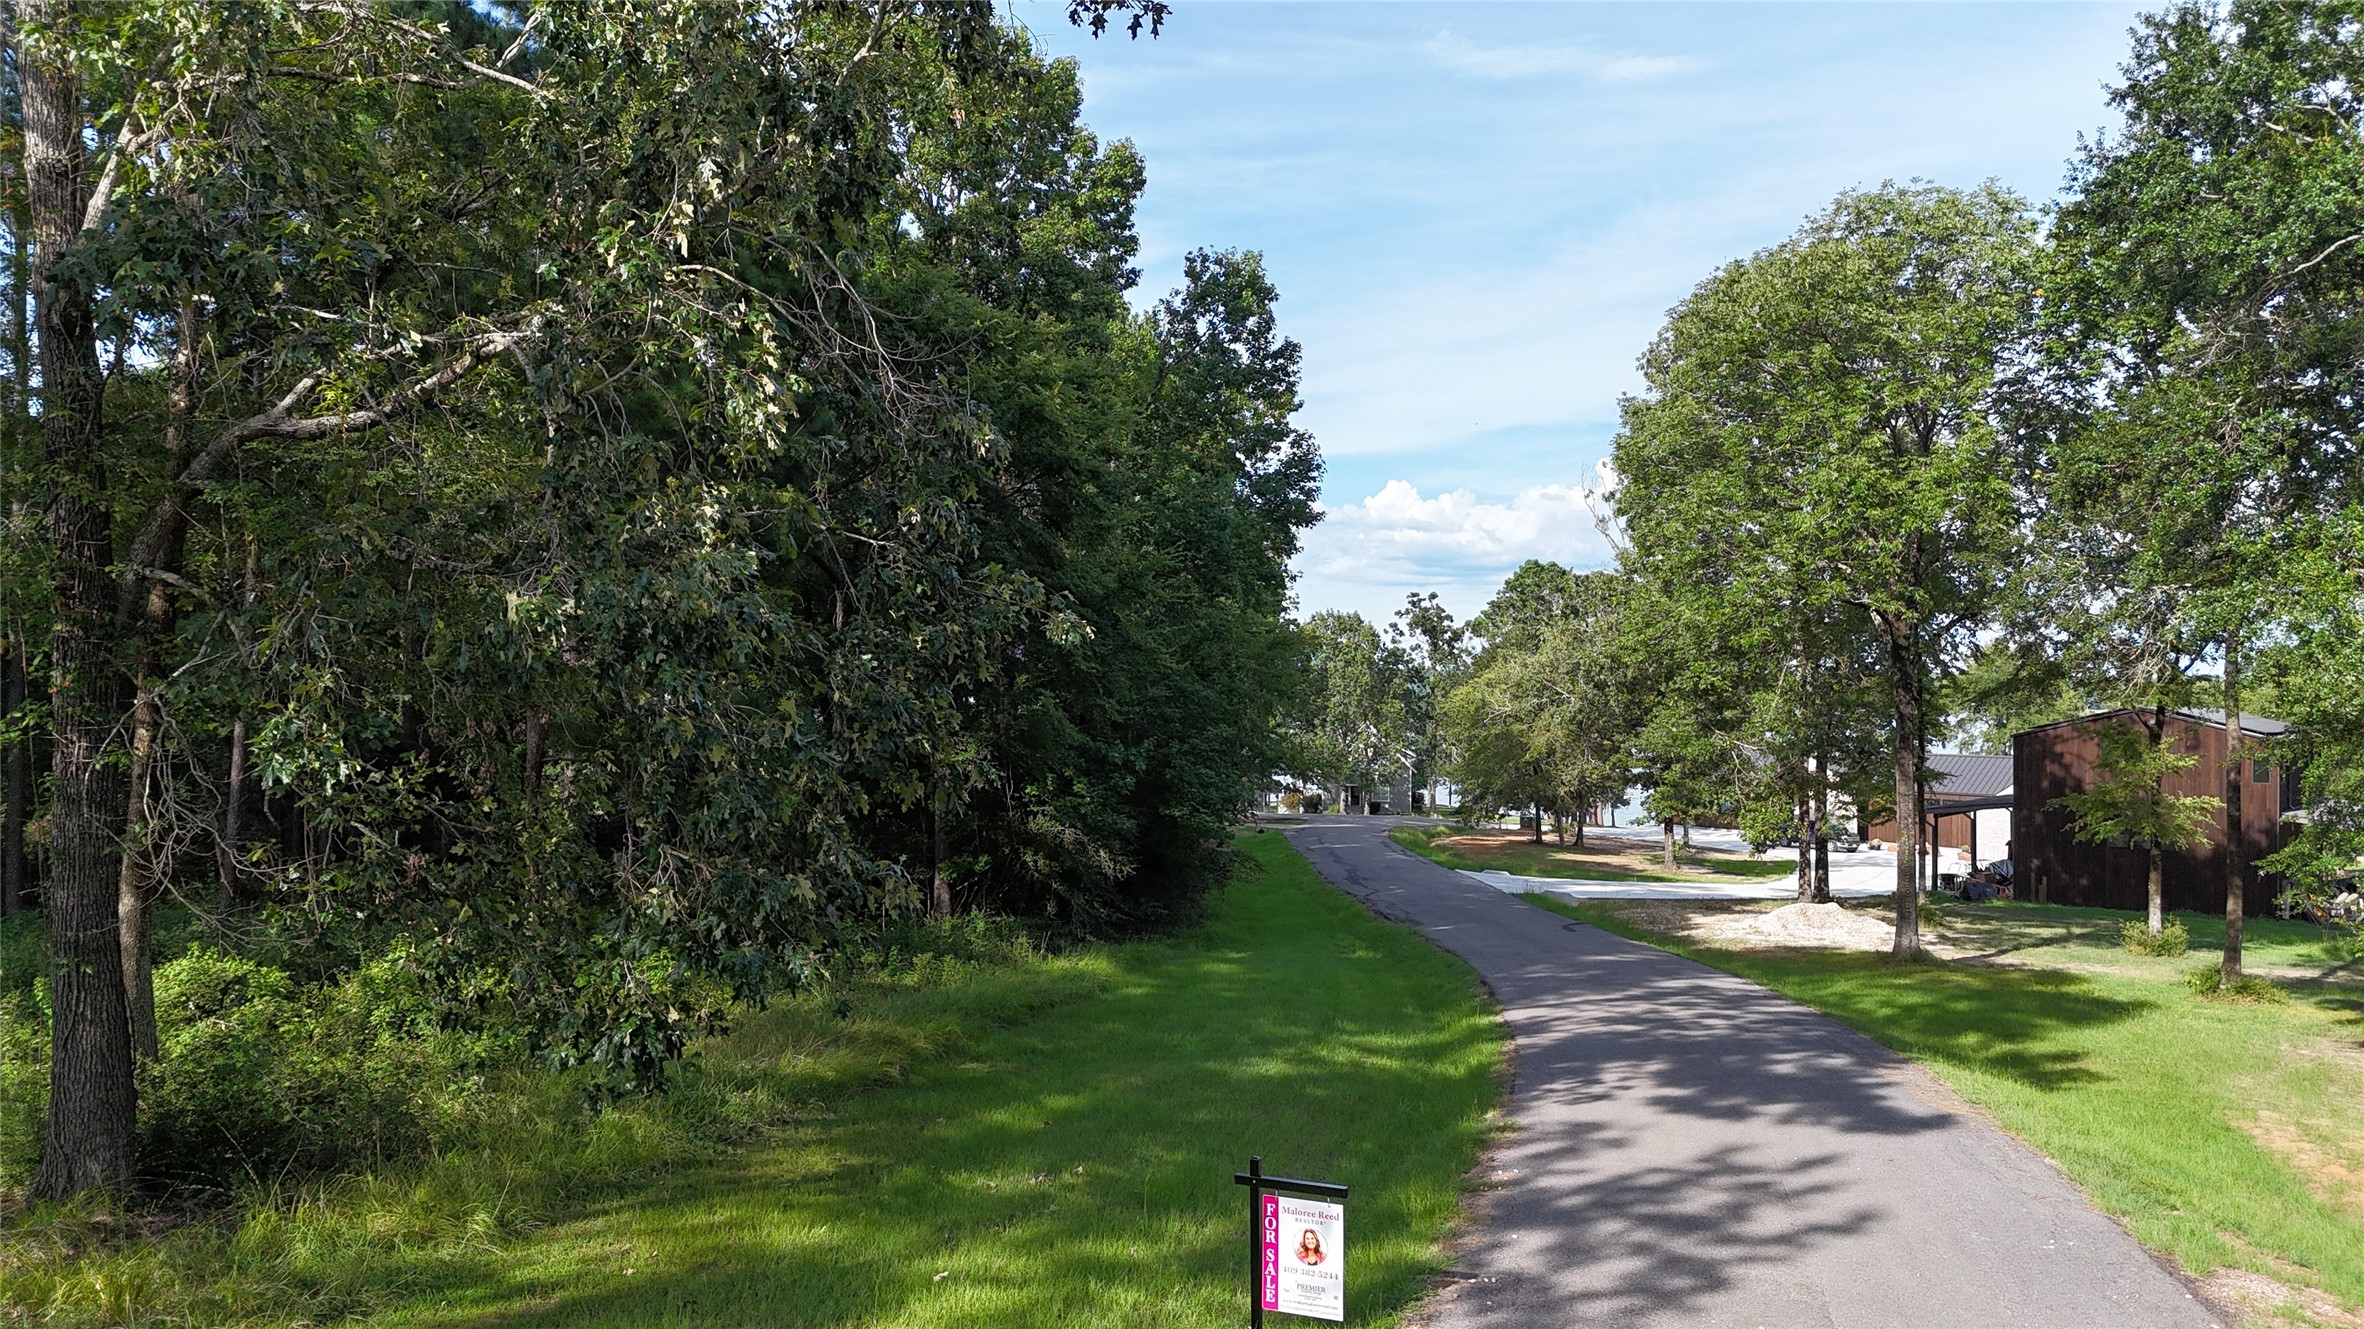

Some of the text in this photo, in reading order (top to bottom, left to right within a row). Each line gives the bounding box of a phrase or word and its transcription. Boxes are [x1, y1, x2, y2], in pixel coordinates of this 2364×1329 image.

[1281, 1206, 1340, 1222] Maloree Reed
[1264, 1203, 1277, 1303] FOR SALE
[1296, 1283, 1327, 1293] PREMIER
